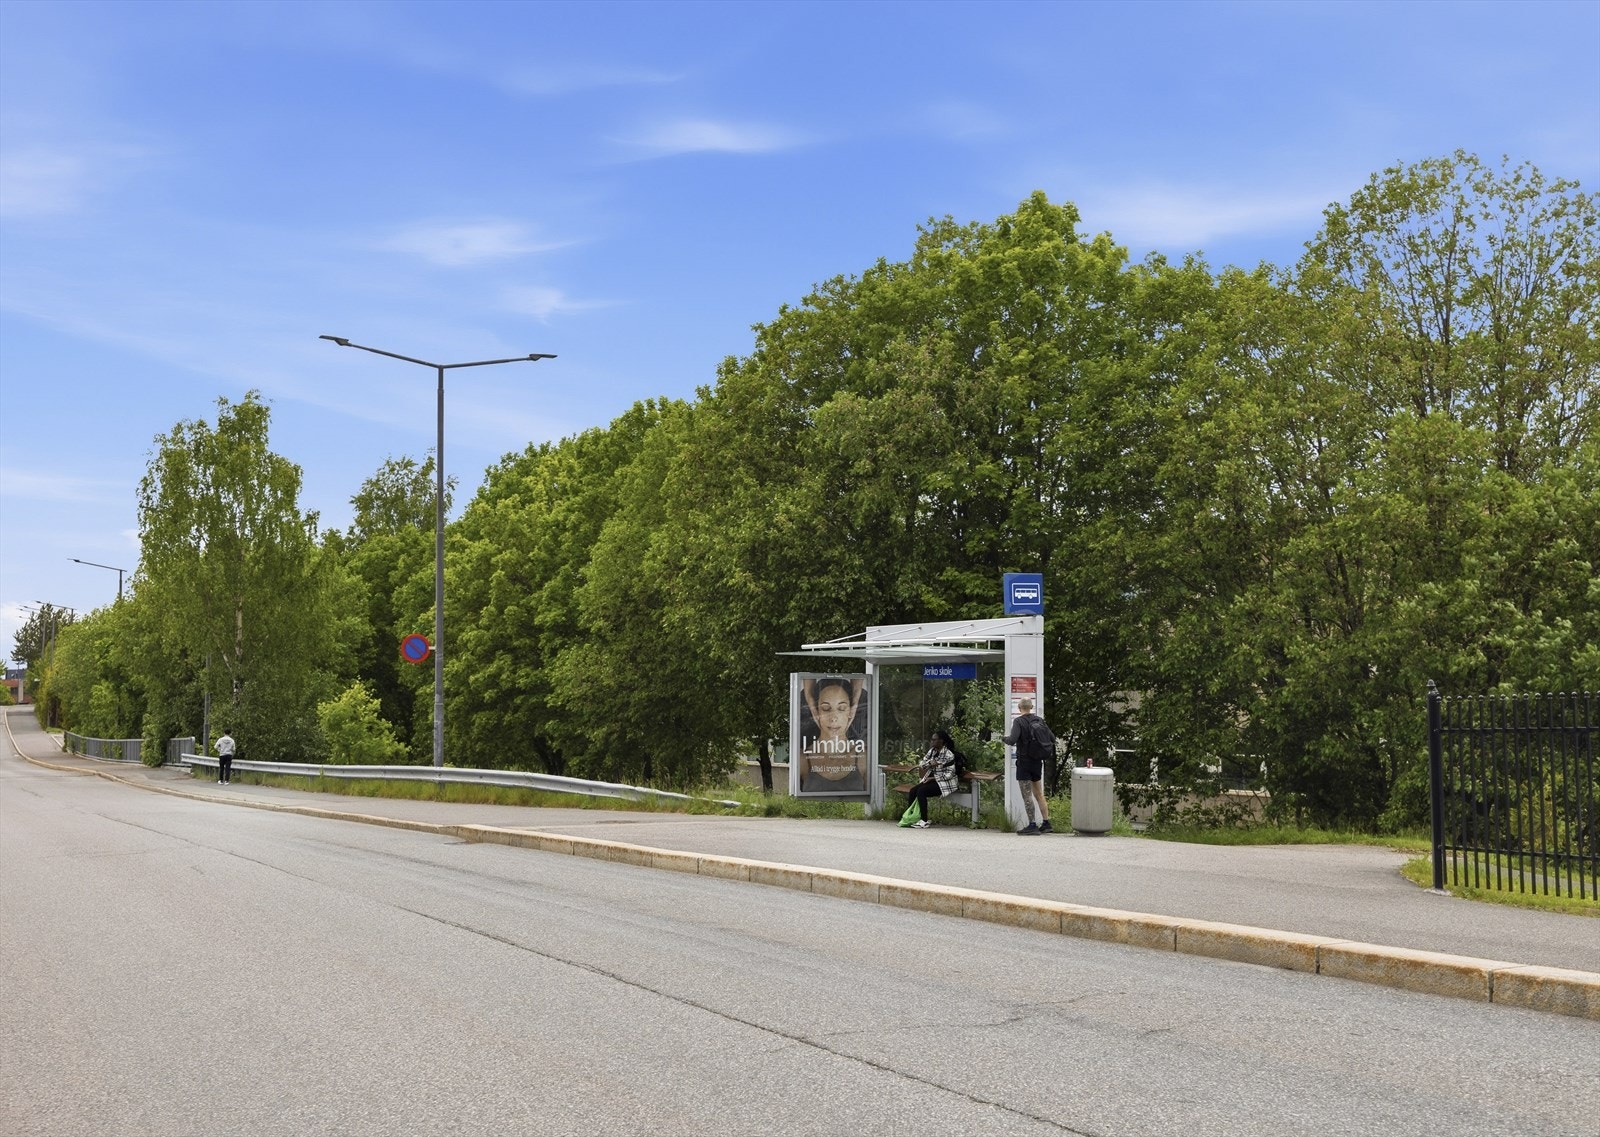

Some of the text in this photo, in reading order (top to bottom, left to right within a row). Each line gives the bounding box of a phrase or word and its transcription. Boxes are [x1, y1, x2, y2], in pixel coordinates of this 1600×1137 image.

[939, 666, 953, 676] skole
[803, 736, 865, 754] Limbra
[826, 766, 840, 774] trygge
